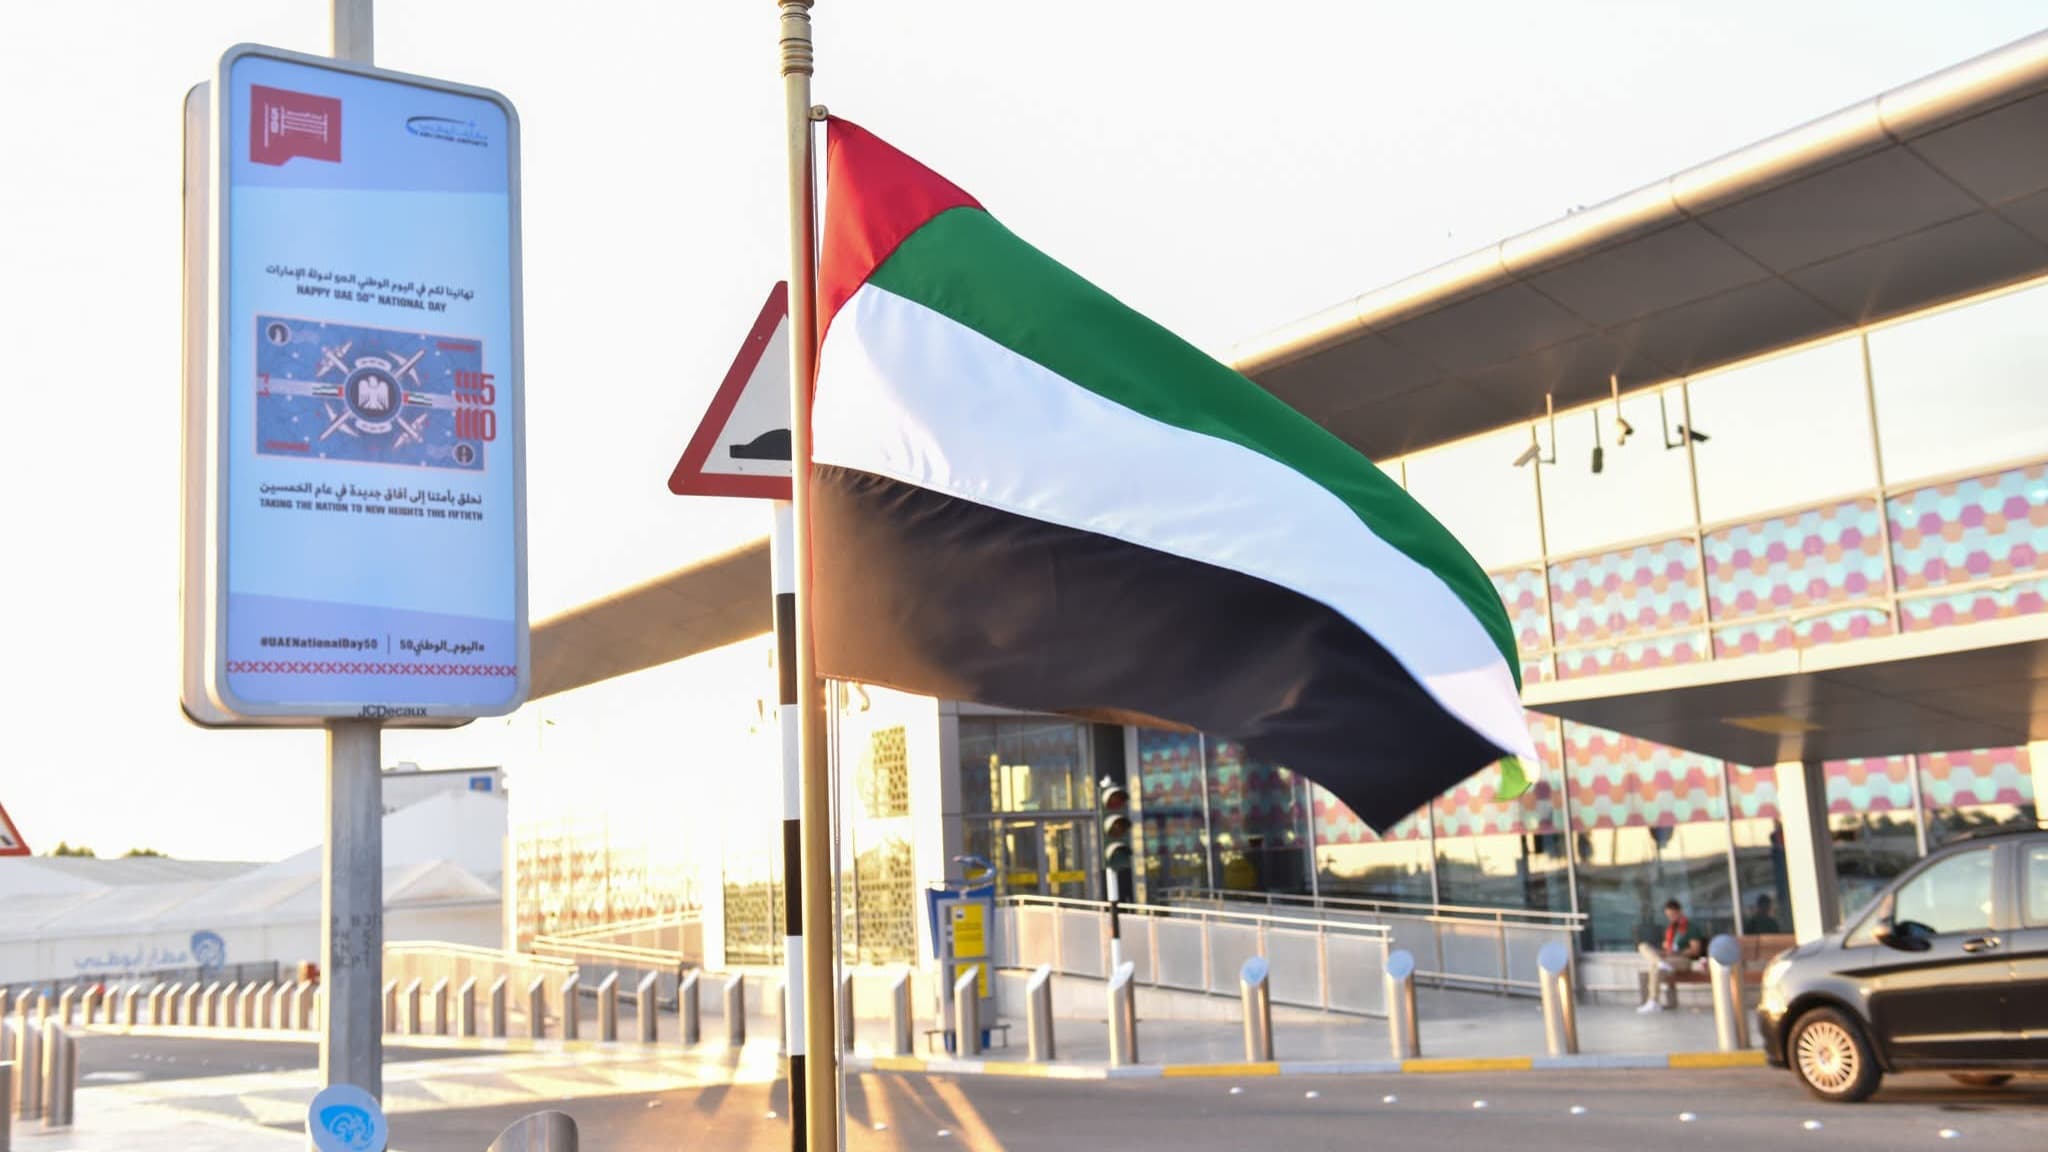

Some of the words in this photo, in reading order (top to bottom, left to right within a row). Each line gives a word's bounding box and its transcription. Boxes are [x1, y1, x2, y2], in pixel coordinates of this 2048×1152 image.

[391, 282, 415, 294] اليوم
[296, 284, 330, 298] HAPPY
[334, 289, 353, 301] UAE
[377, 294, 425, 310] NATIONAL
[427, 301, 447, 313] DAY
[260, 498, 294, 509] TAKING
[296, 500, 313, 511] THE
[315, 501, 349, 512] NATION
[351, 503, 363, 513] TO
[365, 505, 385, 514] NEW
[387, 506, 425, 518] HEIGHTS
[427, 508, 446, 519] THIS
[358, 704, 428, 719] JCDecaux
